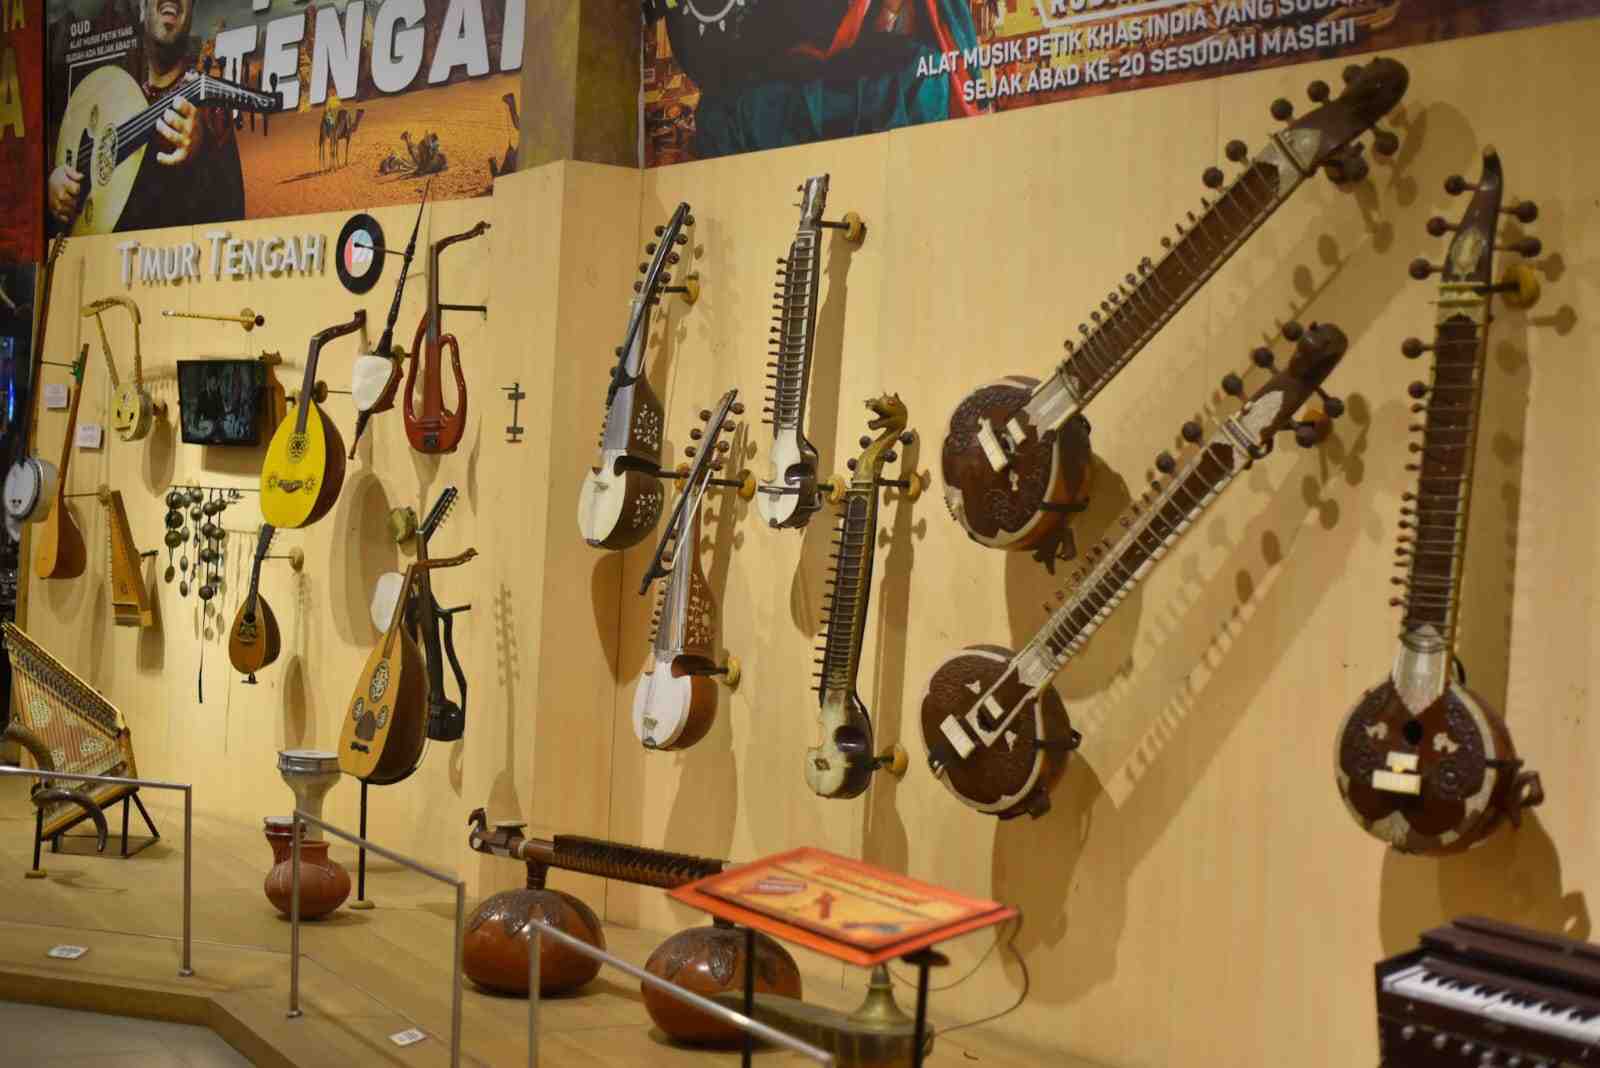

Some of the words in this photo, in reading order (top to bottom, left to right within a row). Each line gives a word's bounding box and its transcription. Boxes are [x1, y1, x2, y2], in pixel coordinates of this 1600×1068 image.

[70, 20, 91, 37] OUD
[916, 51, 959, 78] ALAT
[964, 39, 1023, 70] MUSIK
[1026, 30, 1083, 59] PETIK
[1087, 20, 1144, 50] KHAS
[1149, 13, 1208, 39] INDIA
[1213, 0, 1275, 28] YANG
[1279, 0, 1361, 16] SUD
[962, 72, 1023, 102] SEJAK
[1026, 63, 1079, 93] ABAD
[1085, 52, 1146, 84] KE-20
[1150, 34, 1256, 74] SESUDAH
[1262, 18, 1356, 56] MASEHI
[205, 229, 326, 280] TENGAH
